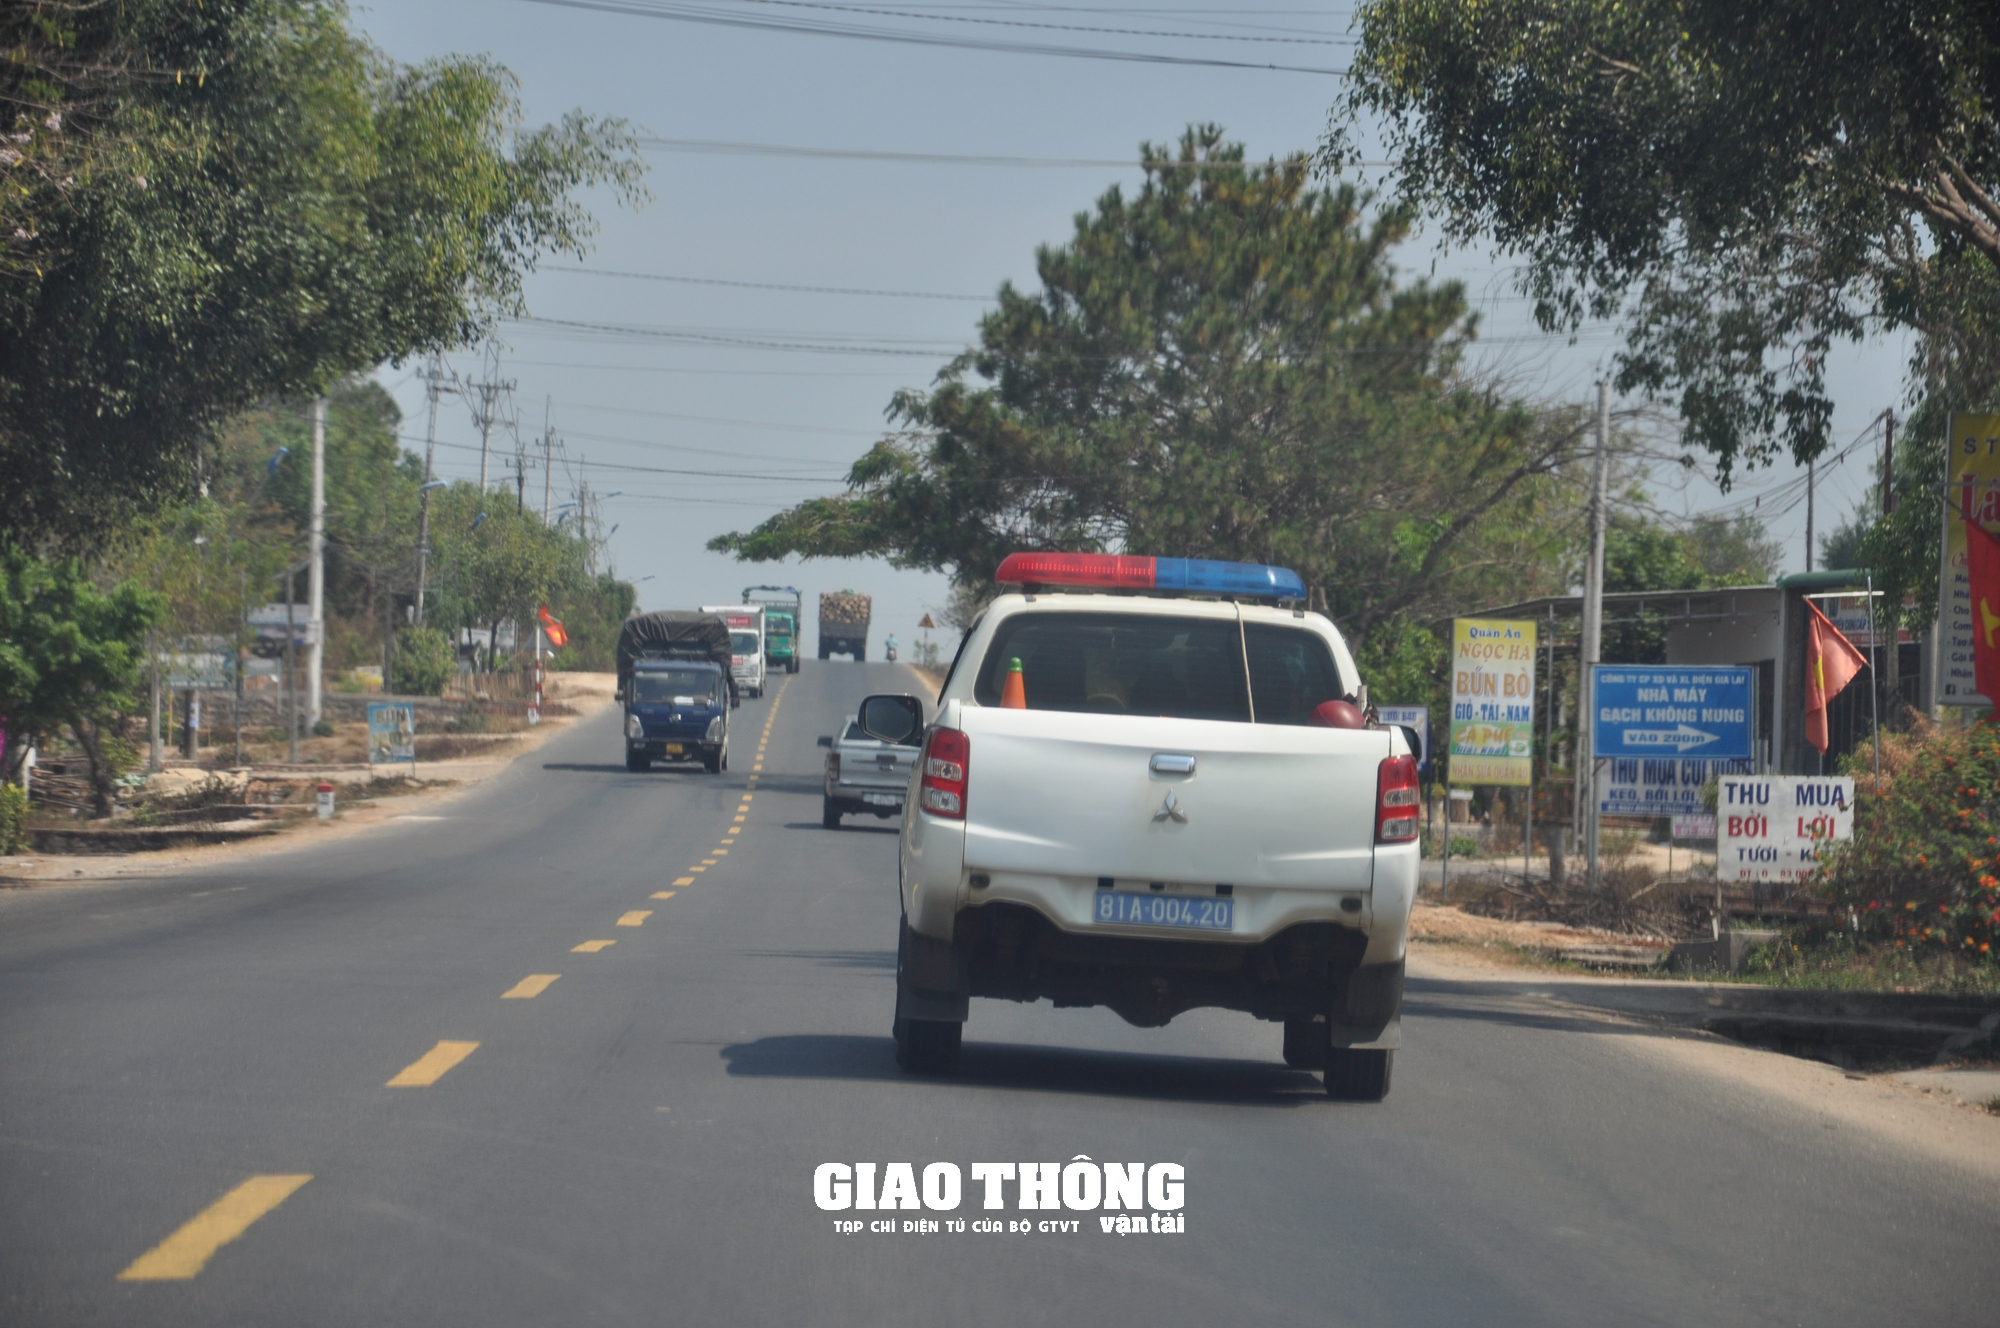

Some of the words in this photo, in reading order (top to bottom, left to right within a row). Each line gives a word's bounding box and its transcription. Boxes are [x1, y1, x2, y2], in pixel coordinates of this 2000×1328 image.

[1470, 626, 1500, 639] Quán
[1459, 642, 1505, 663] NGỌC
[1503, 667, 1530, 698] BÒ
[1627, 675, 1637, 683] TY
[1639, 675, 1650, 683] CP
[1666, 674, 1678, 684] VÀ
[1715, 676, 1729, 684] GIA
[1637, 686, 1669, 702] NHÀ
[1673, 686, 1707, 702] MÁY
[1601, 708, 1641, 725] GẠCH
[1646, 705, 1697, 722] KHÔNG
[1702, 709, 1744, 723] NUNG
[1663, 734, 1705, 743] 200m
[1611, 759, 1637, 784] THU
[1725, 783, 1769, 805] THU
[1796, 784, 1844, 806] MUA
[1728, 809, 1767, 838] BỜI
[1797, 810, 1835, 839] LỜI
[1737, 846, 1777, 862] TƯƠI
